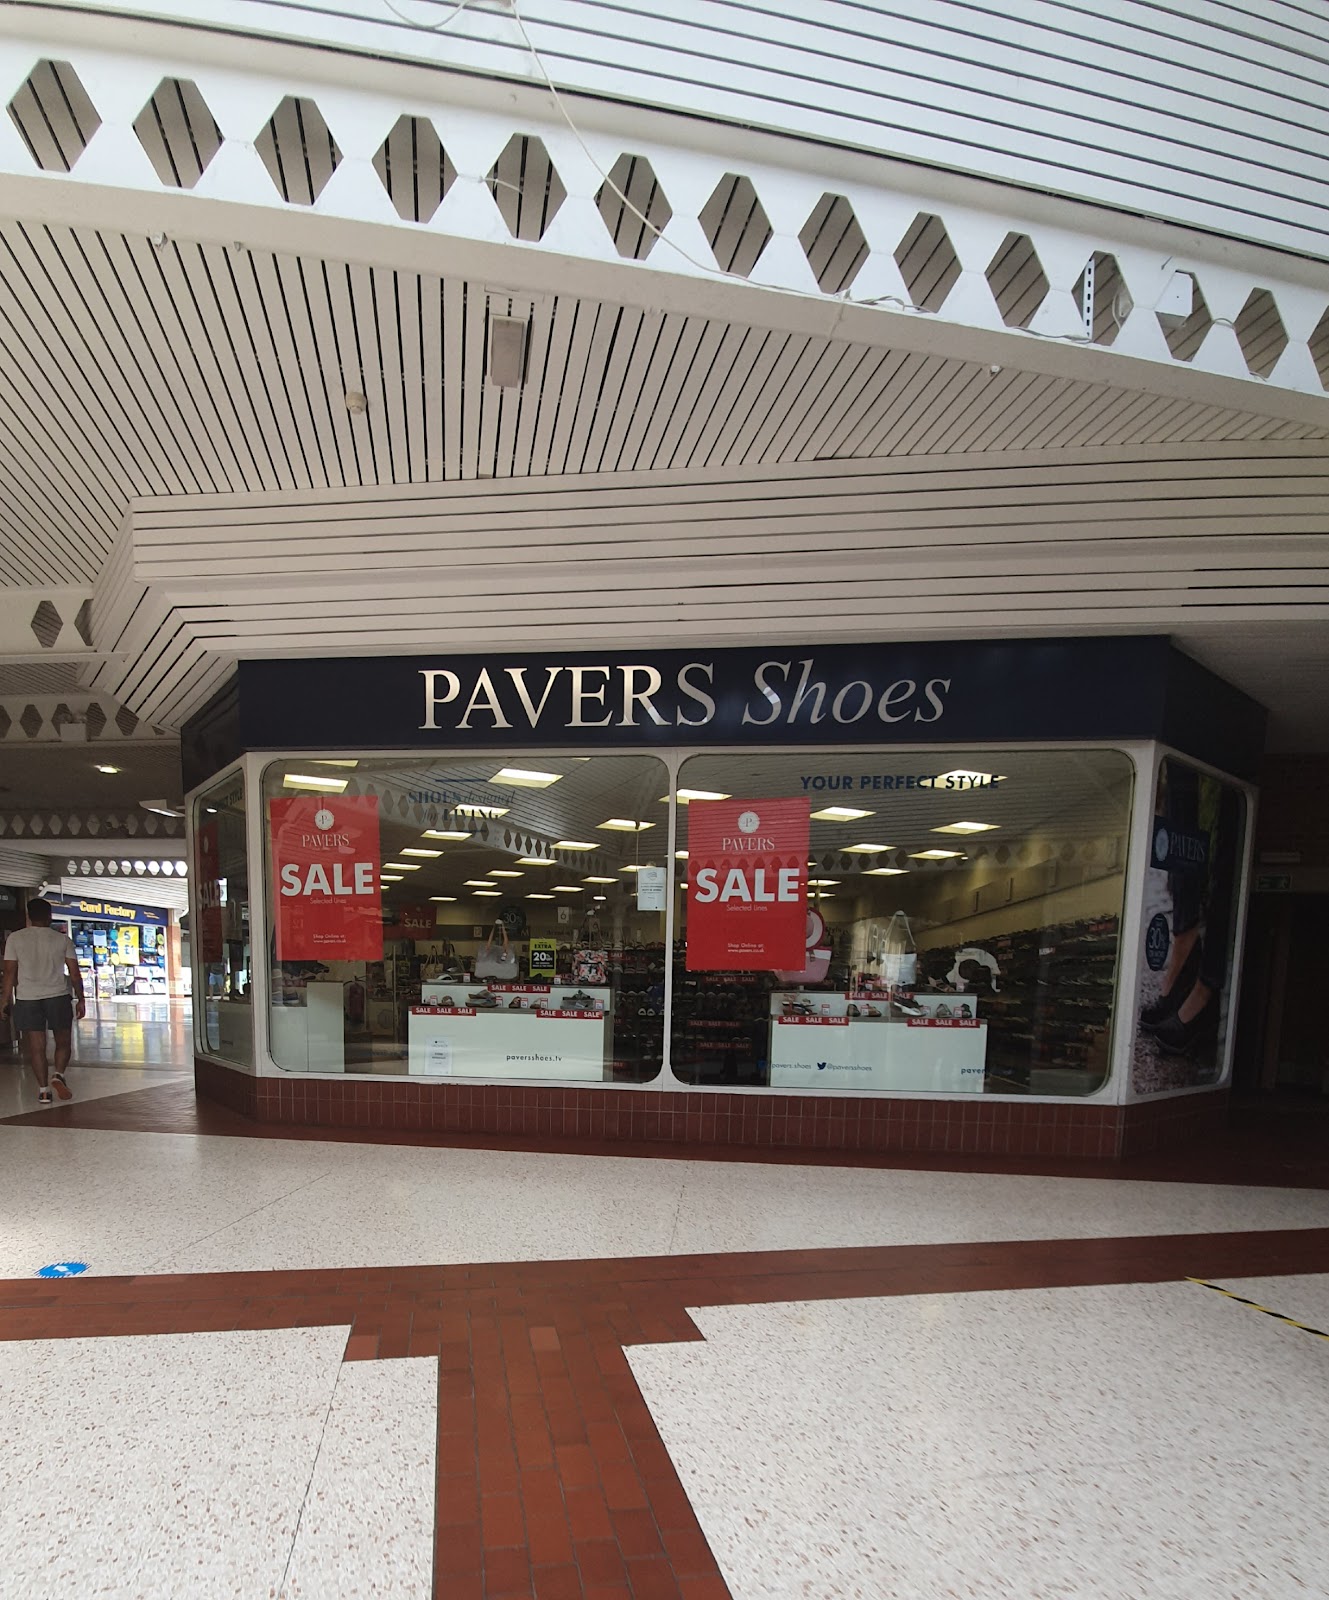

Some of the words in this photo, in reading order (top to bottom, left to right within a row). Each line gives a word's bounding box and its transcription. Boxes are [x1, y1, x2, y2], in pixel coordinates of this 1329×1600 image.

[418, 661, 716, 730] PAVERS
[741, 658, 951, 727] Shoes
[800, 775, 853, 790] YOUR
[860, 775, 938, 790] PERFECT
[945, 774, 999, 789] STYLE
[408, 791, 461, 804] SHOES
[301, 833, 351, 848] PAVERS
[721, 837, 776, 851] PAVERS
[280, 862, 375, 896] SALE
[694, 867, 800, 902] SALE
[79, 900, 102, 914] Card
[104, 903, 136, 920] Factory
[726, 903, 752, 912] Selected
[403, 917, 432, 929] SALE
[491, 984, 507, 992] SALE
[532, 985, 548, 993] SALE
[561, 1010, 578, 1018] SALE
[782, 1016, 800, 1024] SALE
[805, 1016, 823, 1024] SALE
[828, 1017, 846, 1025] SALE
[912, 1018, 930, 1026] SALE
[935, 1018, 953, 1026] SALE
[959, 1019, 977, 1027] SALE
[505, 1053, 563, 1063] paversshoes.tv
[827, 1063, 873, 1071] @paversshoes
